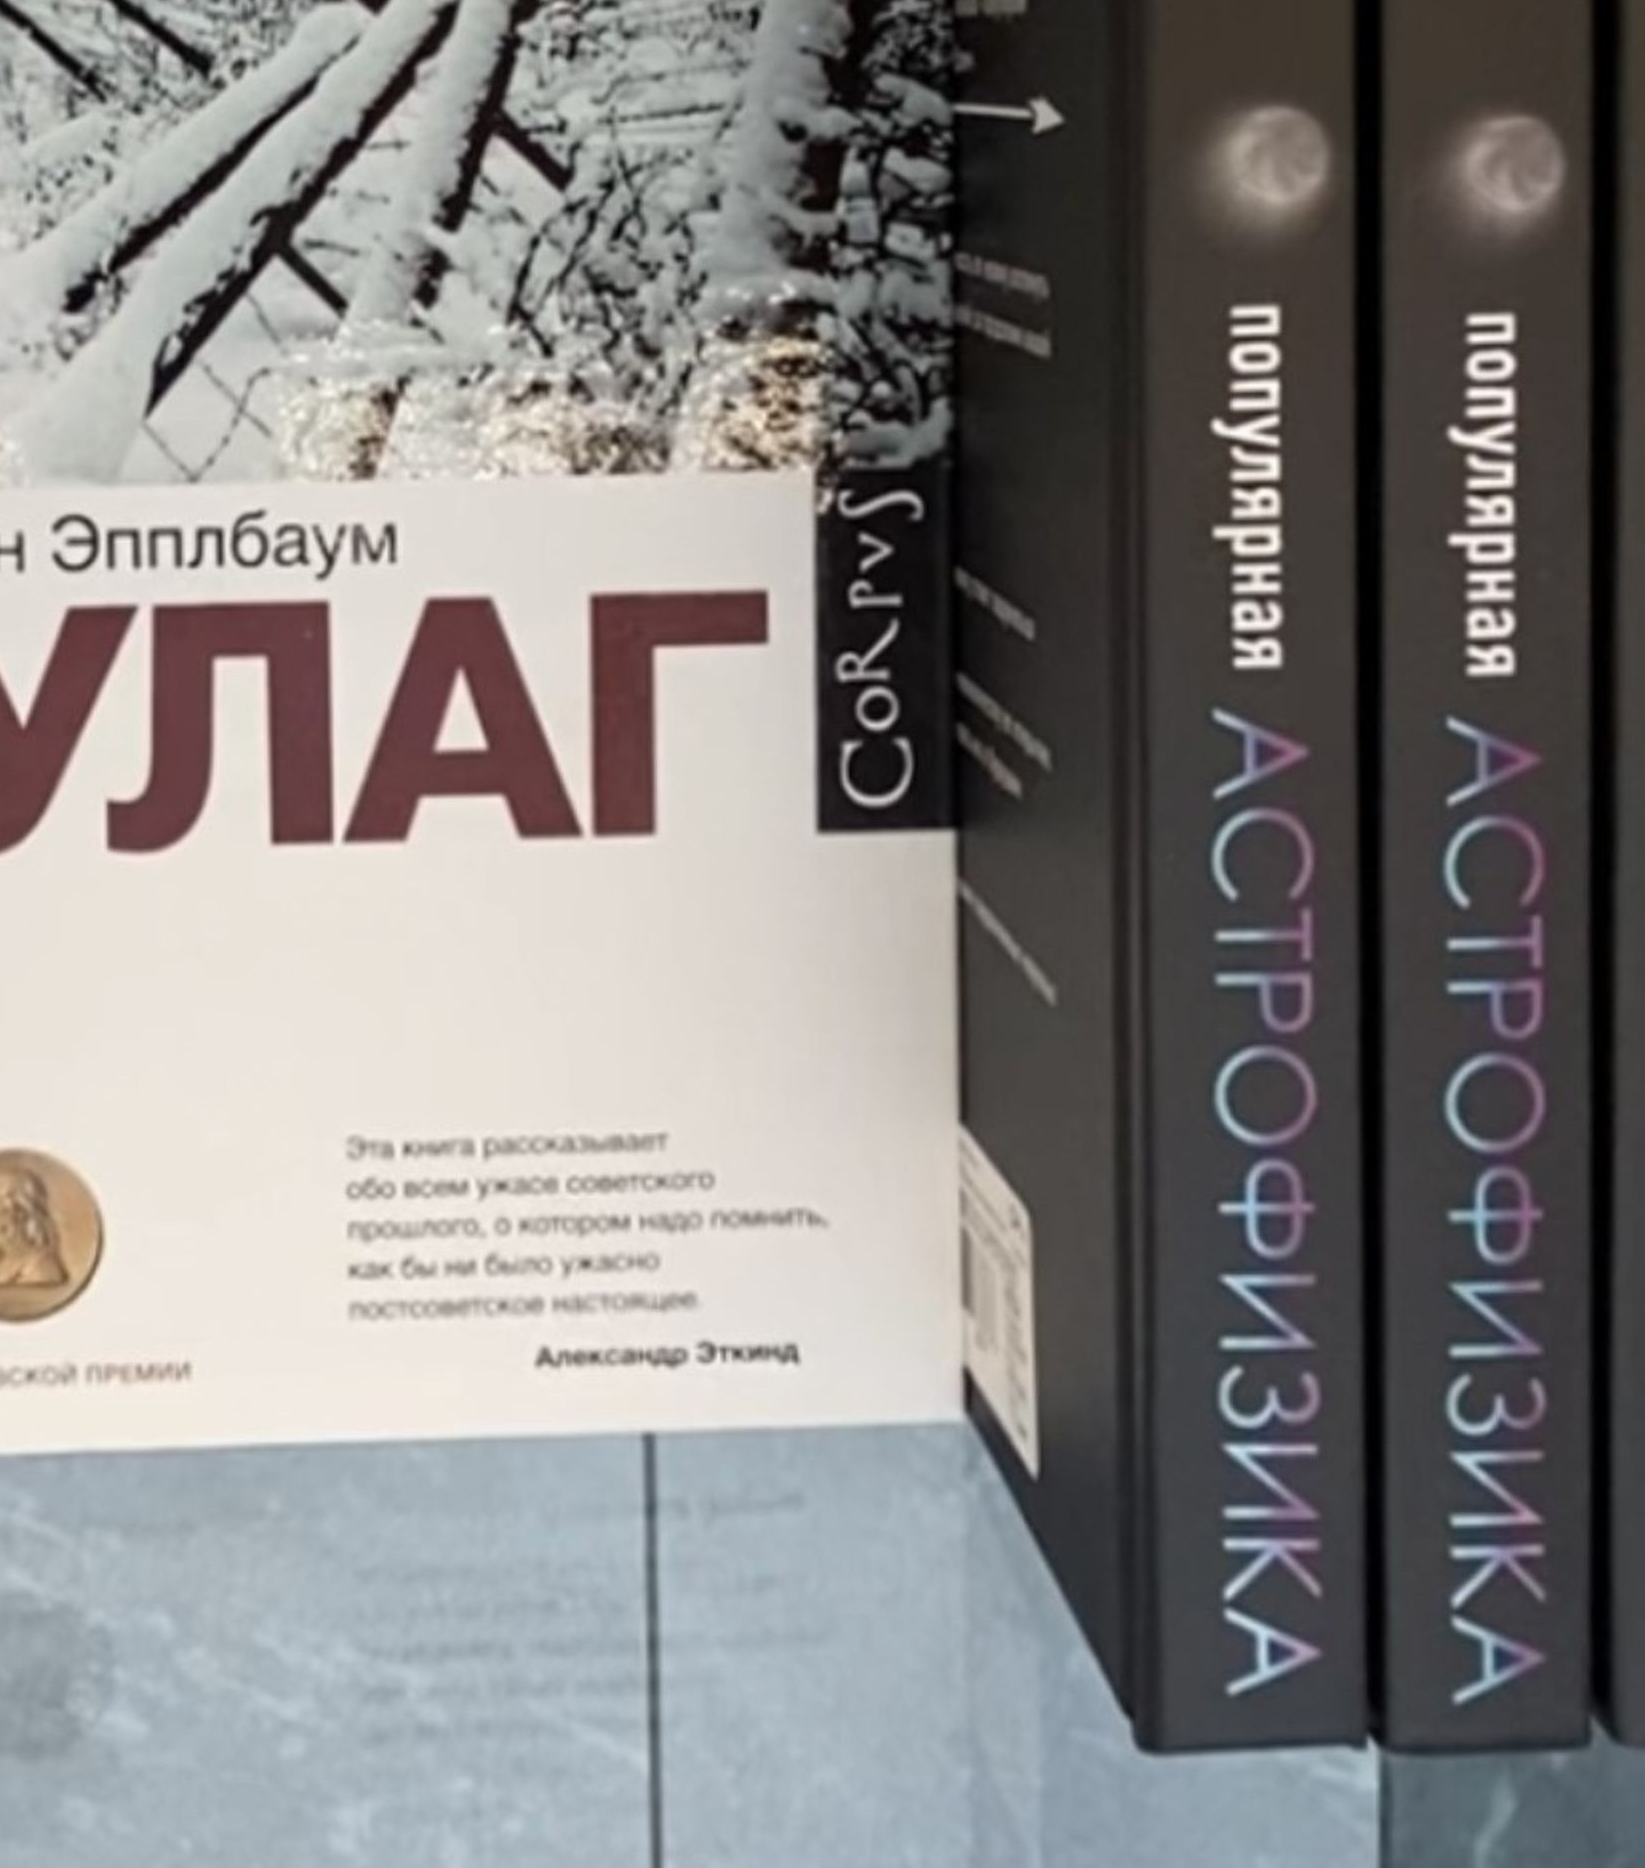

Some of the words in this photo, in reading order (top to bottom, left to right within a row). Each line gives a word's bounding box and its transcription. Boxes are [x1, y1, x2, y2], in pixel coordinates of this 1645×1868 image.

[49, 511, 402, 582] Эпплбаум
[346, 1134, 395, 1161] Эта
[402, 1135, 476, 1160] книга
[482, 1130, 668, 1162] рассказывает
[346, 1177, 396, 1201] обо
[402, 1177, 469, 1199] всем
[565, 1169, 715, 1195] советского
[1211, 706, 1324, 1699] АСТРОФИЗИКА
[1444, 714, 1548, 1707] АСТРОФИЗИКА
[518, 1212, 632, 1235] котором
[639, 1209, 702, 1236] надо
[348, 1258, 395, 1281] как
[484, 1250, 553, 1279] было
[560, 1250, 660, 1280] ужасно
[348, 1293, 544, 1323] постсоветское
[534, 1343, 689, 1372] Александр
[695, 1338, 802, 1366] Эткинд
[84, 1361, 195, 1386] ПРЕМИИ
